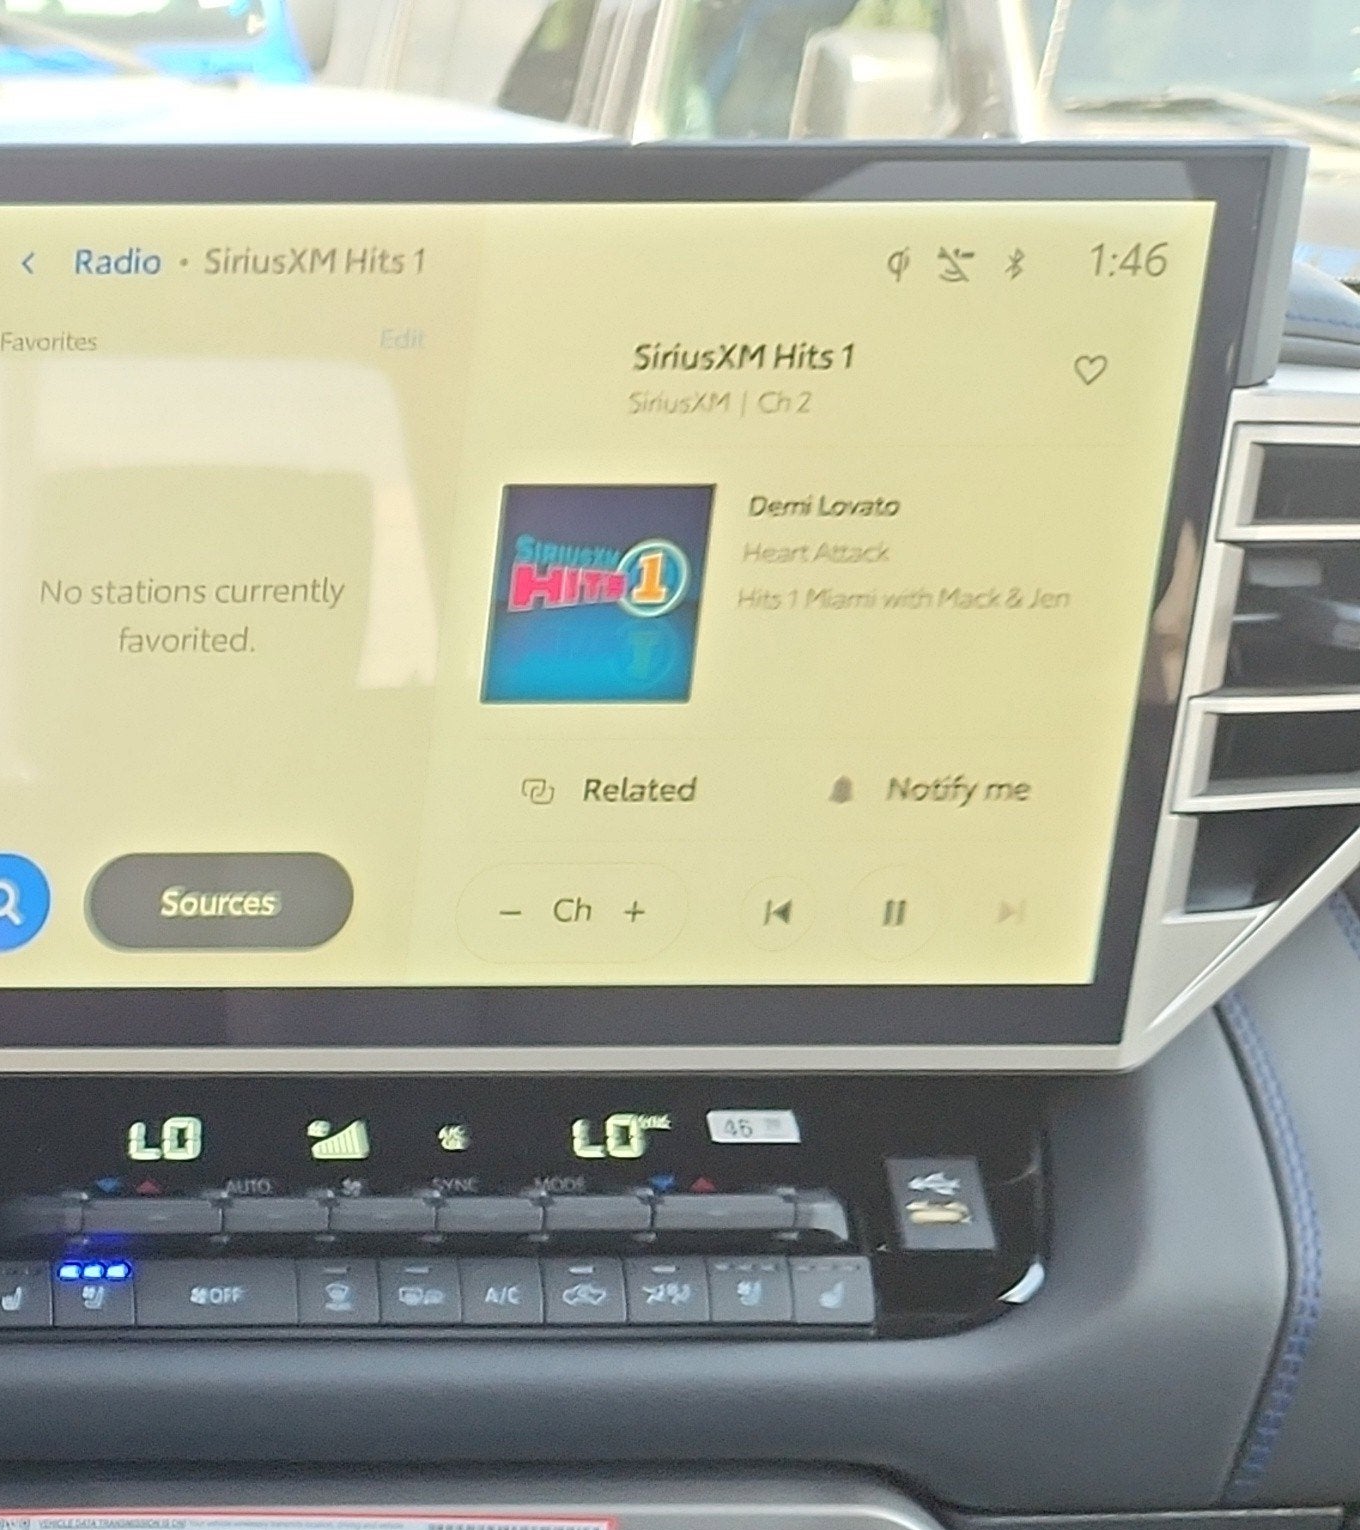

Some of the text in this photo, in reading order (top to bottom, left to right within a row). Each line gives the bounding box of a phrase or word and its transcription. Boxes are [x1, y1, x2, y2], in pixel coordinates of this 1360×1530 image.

[74, 247, 427, 277] Radio SiriusXM Hits 1
[1087, 242, 1169, 278] 1:46
[632, 341, 855, 371] SiriusXM Hits 1
[628, 390, 813, 415] SiriusXM Ch 2
[749, 494, 901, 518] Demi Lovato
[742, 541, 891, 564] Heart Attack
[39, 576, 347, 609] No stations currently
[508, 551, 669, 613] HITS 1
[117, 625, 257, 654] favorited.
[582, 776, 699, 803] Related
[886, 773, 1033, 807] Notify me
[160, 886, 279, 917] Sources
[552, 897, 592, 924] Ch
[210, 1286, 244, 1304] OFF
[485, 1286, 522, 1305] A/C
